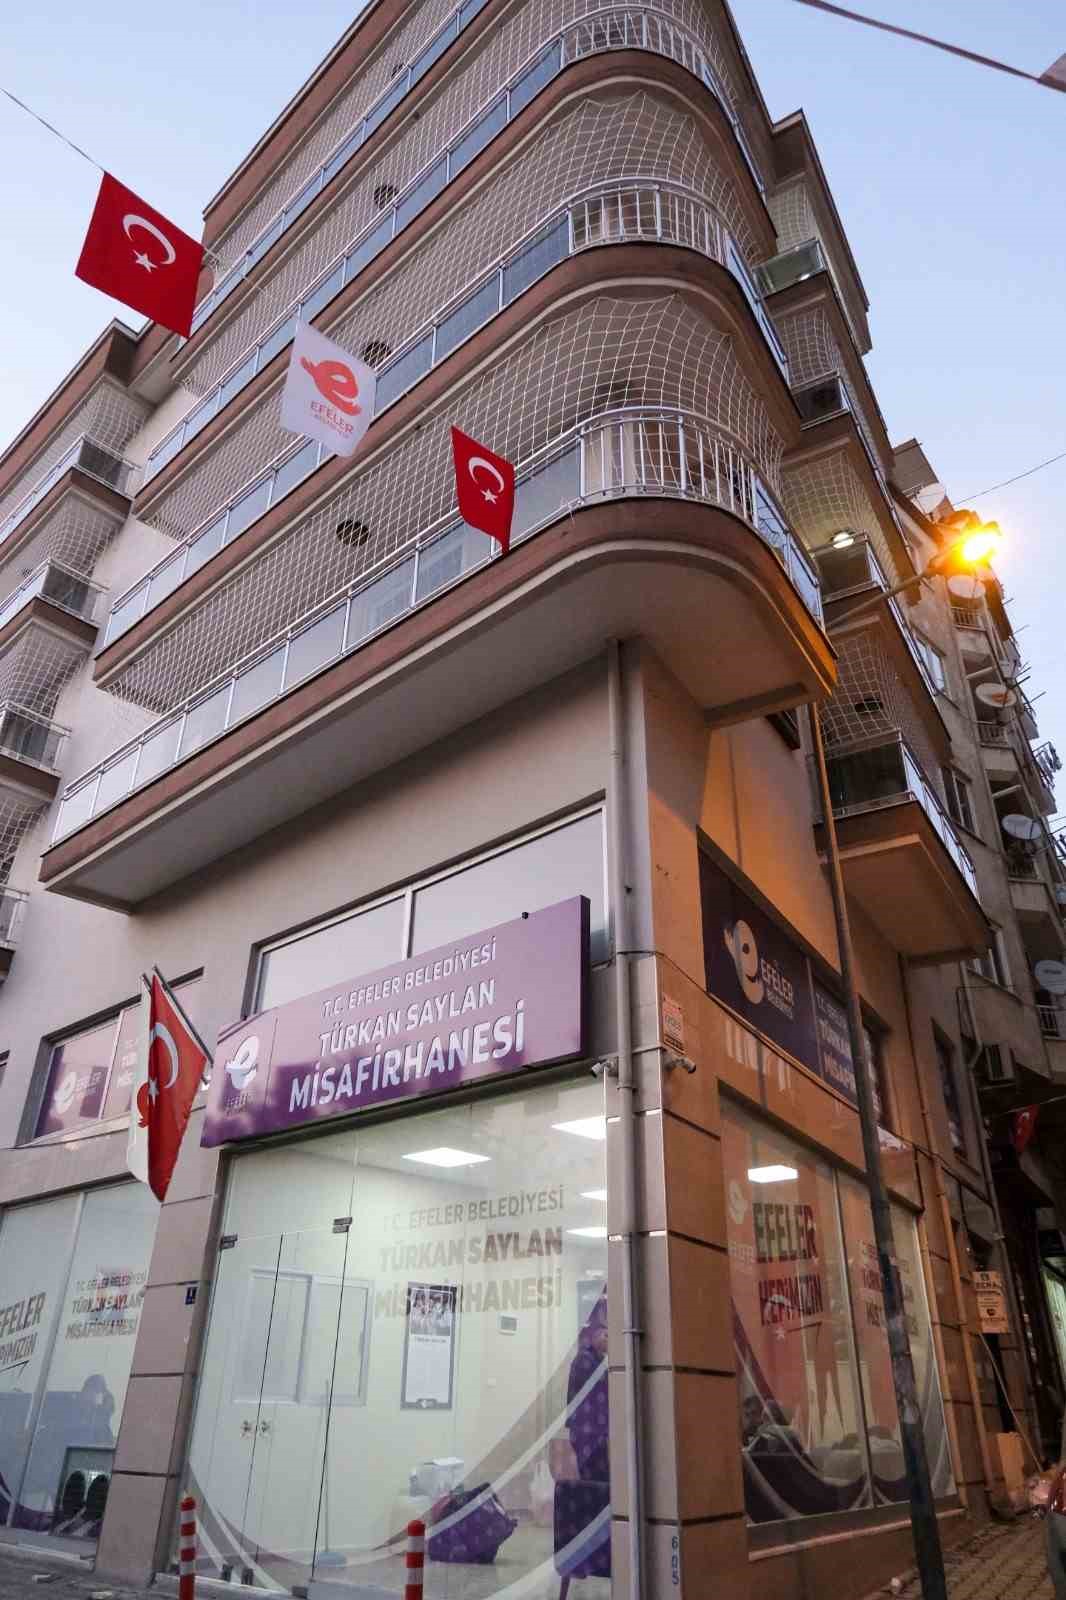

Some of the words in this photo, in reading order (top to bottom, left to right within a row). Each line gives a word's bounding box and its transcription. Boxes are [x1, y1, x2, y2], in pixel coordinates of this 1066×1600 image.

[310, 401, 354, 434] EFELER
[349, 976, 400, 1011] EFELER
[404, 936, 497, 992] BELEDİYESİ
[319, 1008, 400, 1057] TÜRKAN
[405, 979, 496, 1031] SAYLAN
[288, 1000, 526, 1113] MİSAFİRHANESİ
[409, 1203, 464, 1229] EFELER
[467, 1184, 564, 1222] BELEDİYESİ
[752, 1202, 819, 1264] EFELER
[379, 1237, 465, 1273] TÜRKAN
[467, 1225, 563, 1264] SAYLAN
[0, 1291, 46, 1338] FELER
